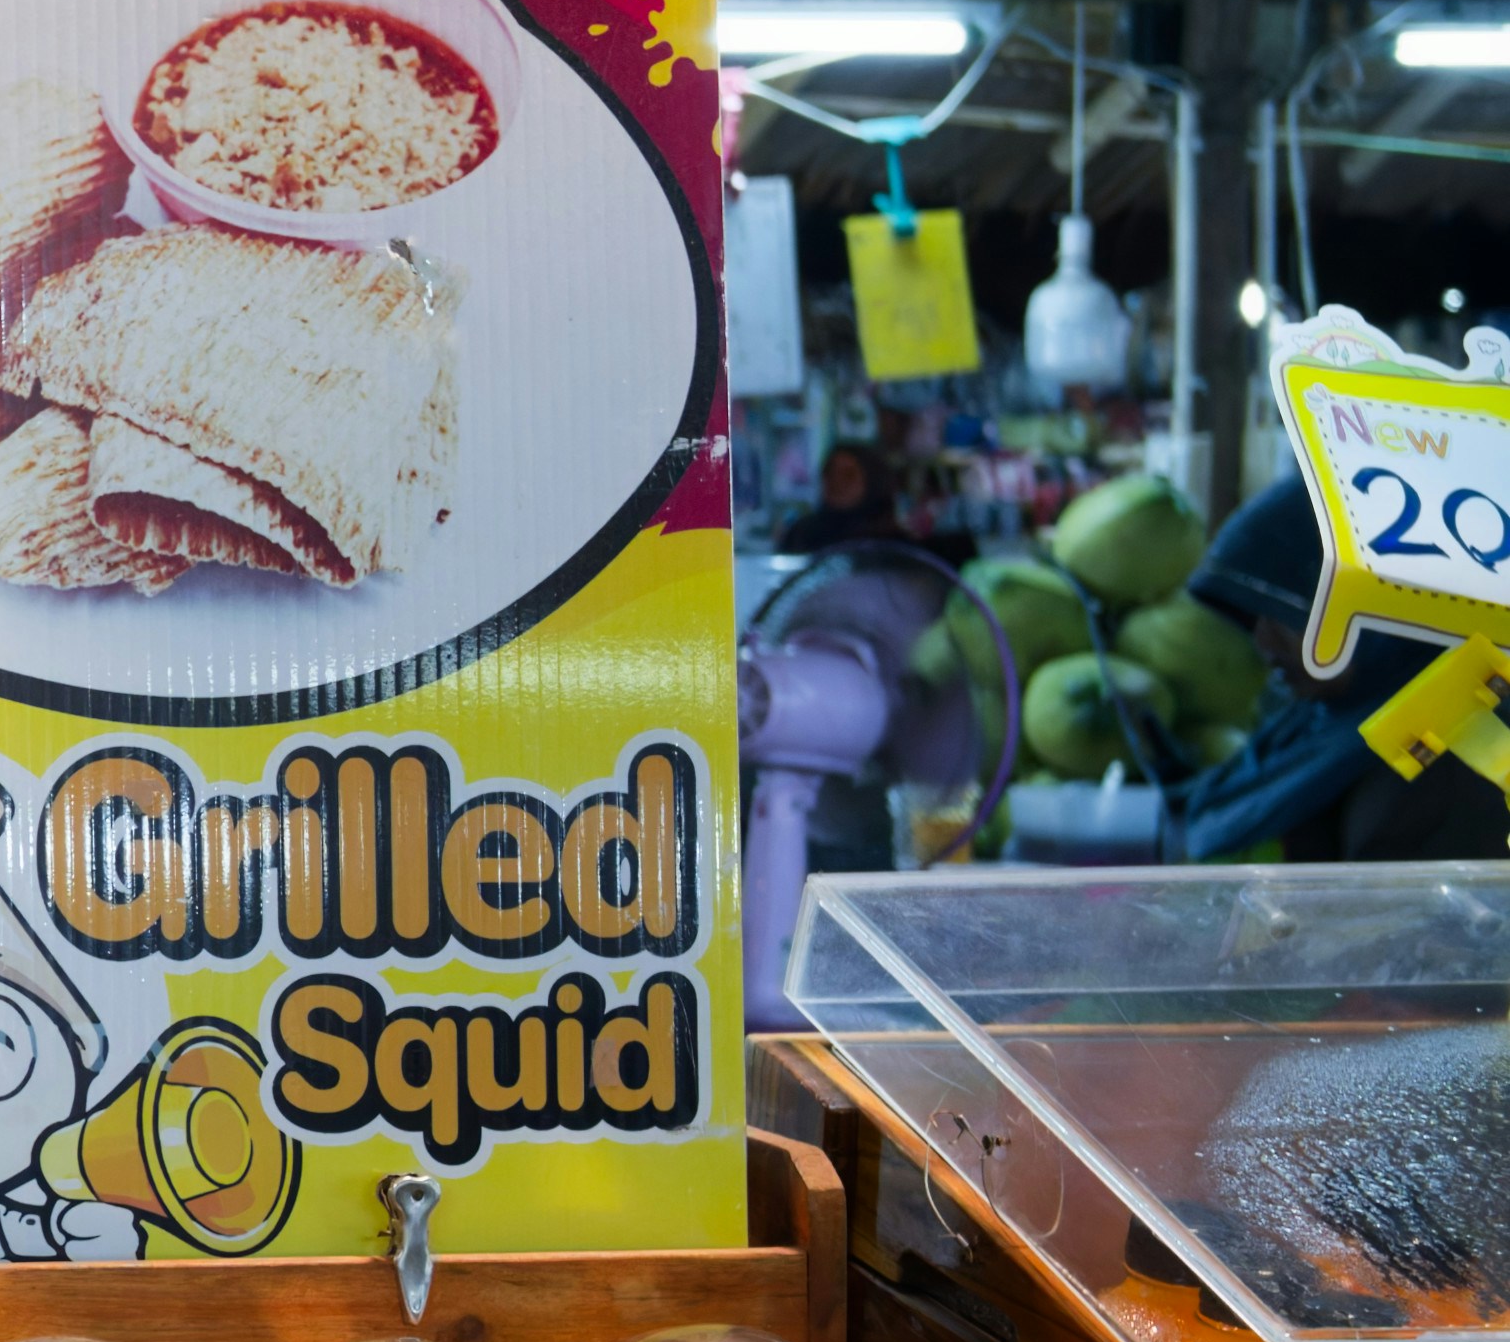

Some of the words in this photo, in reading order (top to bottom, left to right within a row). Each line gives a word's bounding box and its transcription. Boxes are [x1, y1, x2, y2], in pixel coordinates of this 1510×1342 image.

[1329, 403, 1449, 459] New
[39, 745, 695, 957] Grilled
[272, 973, 695, 1162] Squid
